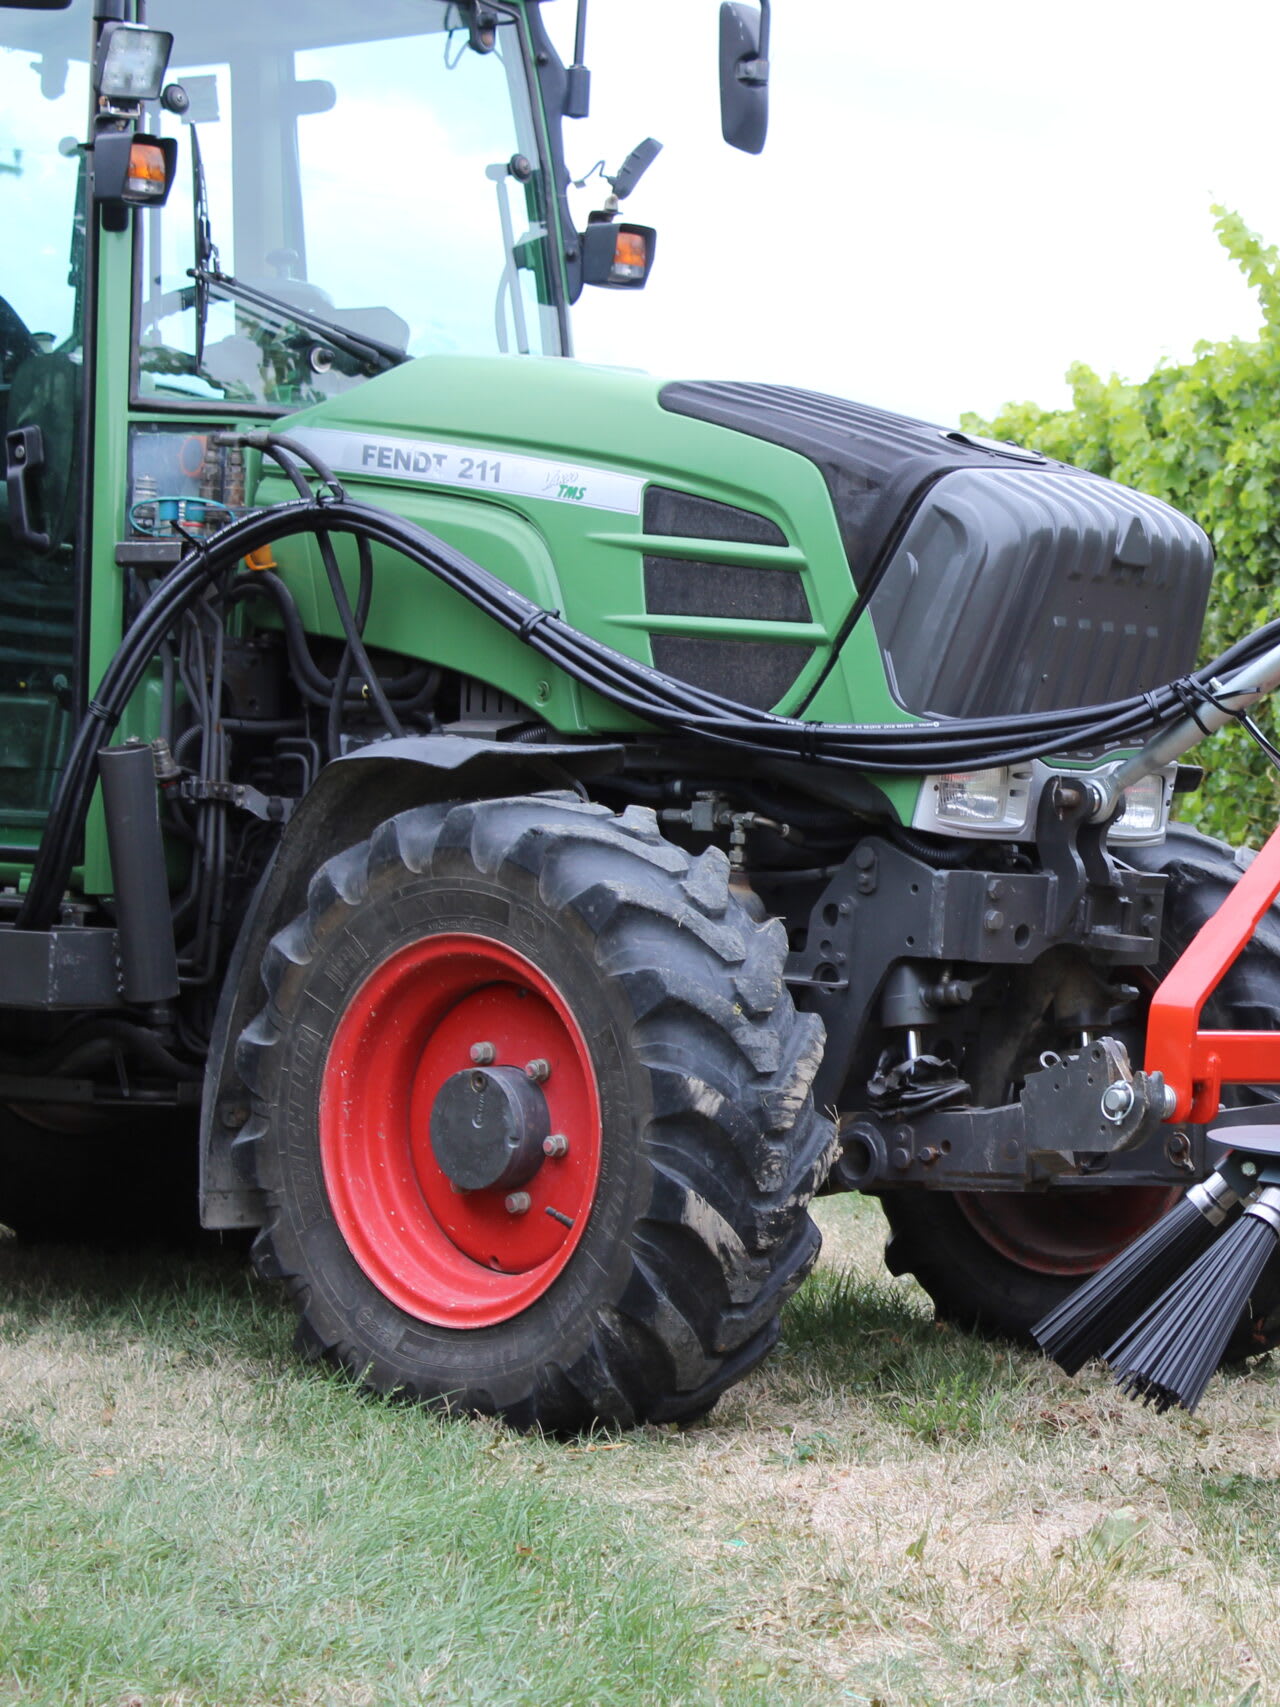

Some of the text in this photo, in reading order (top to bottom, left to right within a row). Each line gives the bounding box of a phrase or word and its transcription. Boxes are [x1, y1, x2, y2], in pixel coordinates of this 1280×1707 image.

[361, 443, 502, 483] FENDT 211
[557, 484, 587, 500] TMS
